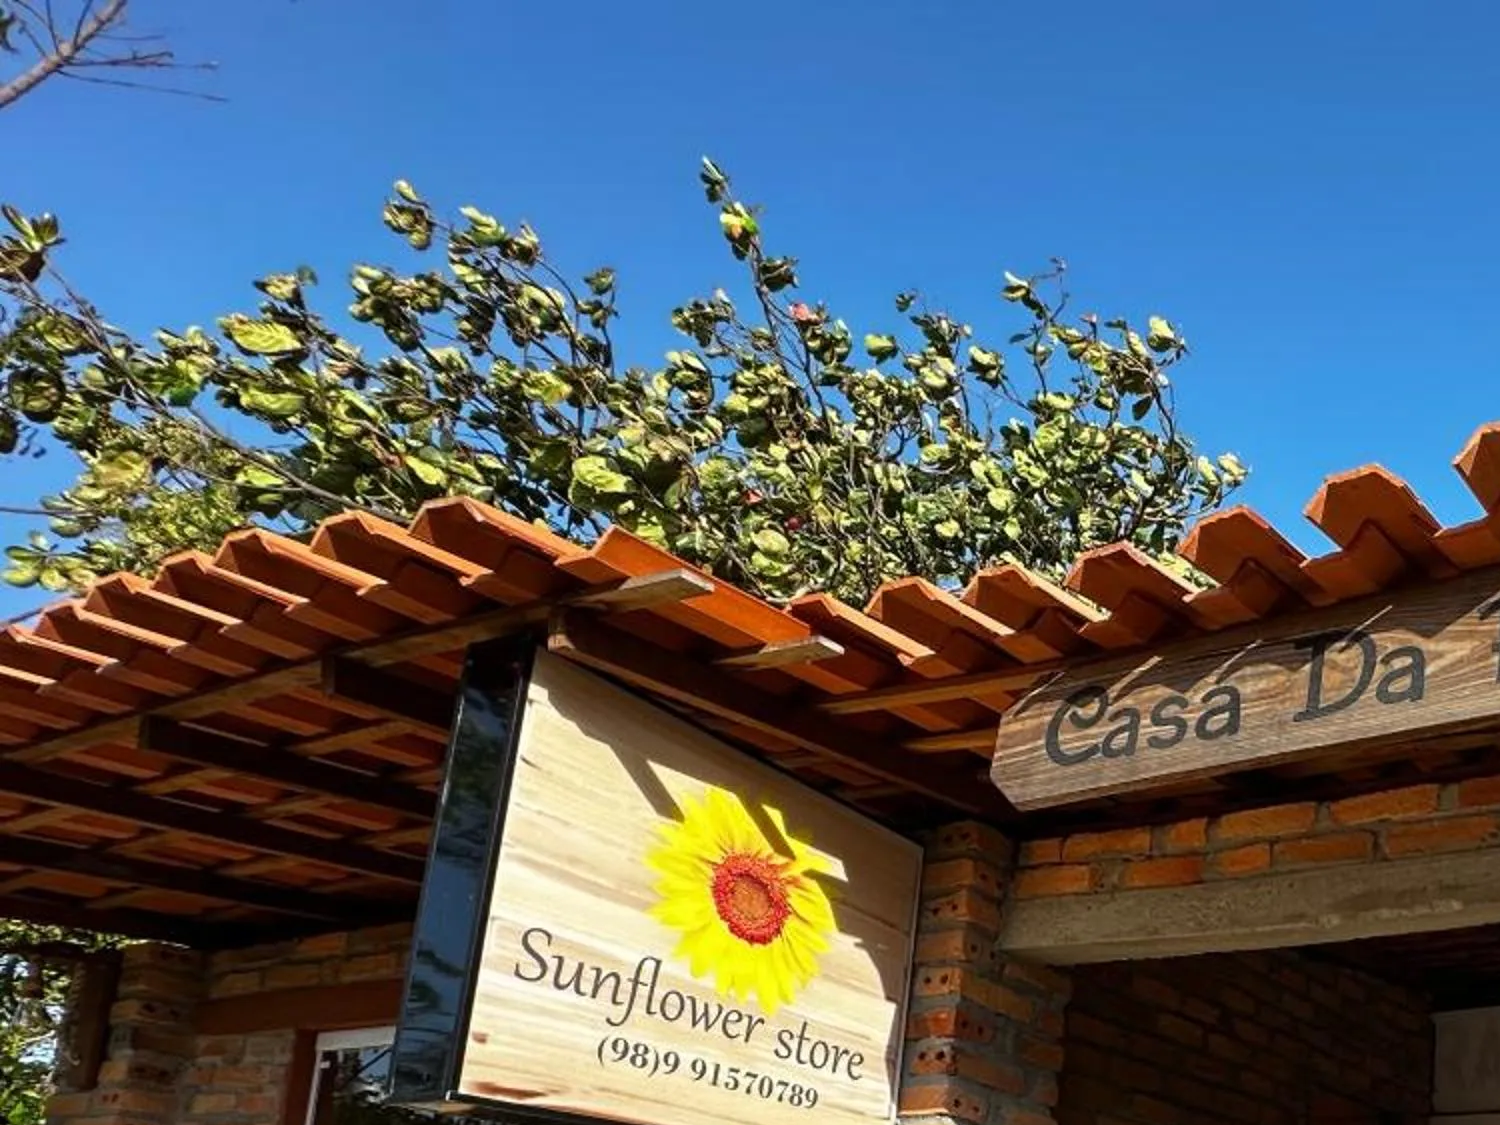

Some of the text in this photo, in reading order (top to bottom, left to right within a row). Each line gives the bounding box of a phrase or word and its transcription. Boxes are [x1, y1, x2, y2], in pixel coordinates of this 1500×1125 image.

[1043, 680, 1243, 767] Casa
[1293, 628, 1426, 723] Da
[513, 927, 865, 1082] Sunflower store
[597, 1035, 820, 1110] (98)9 91570789
